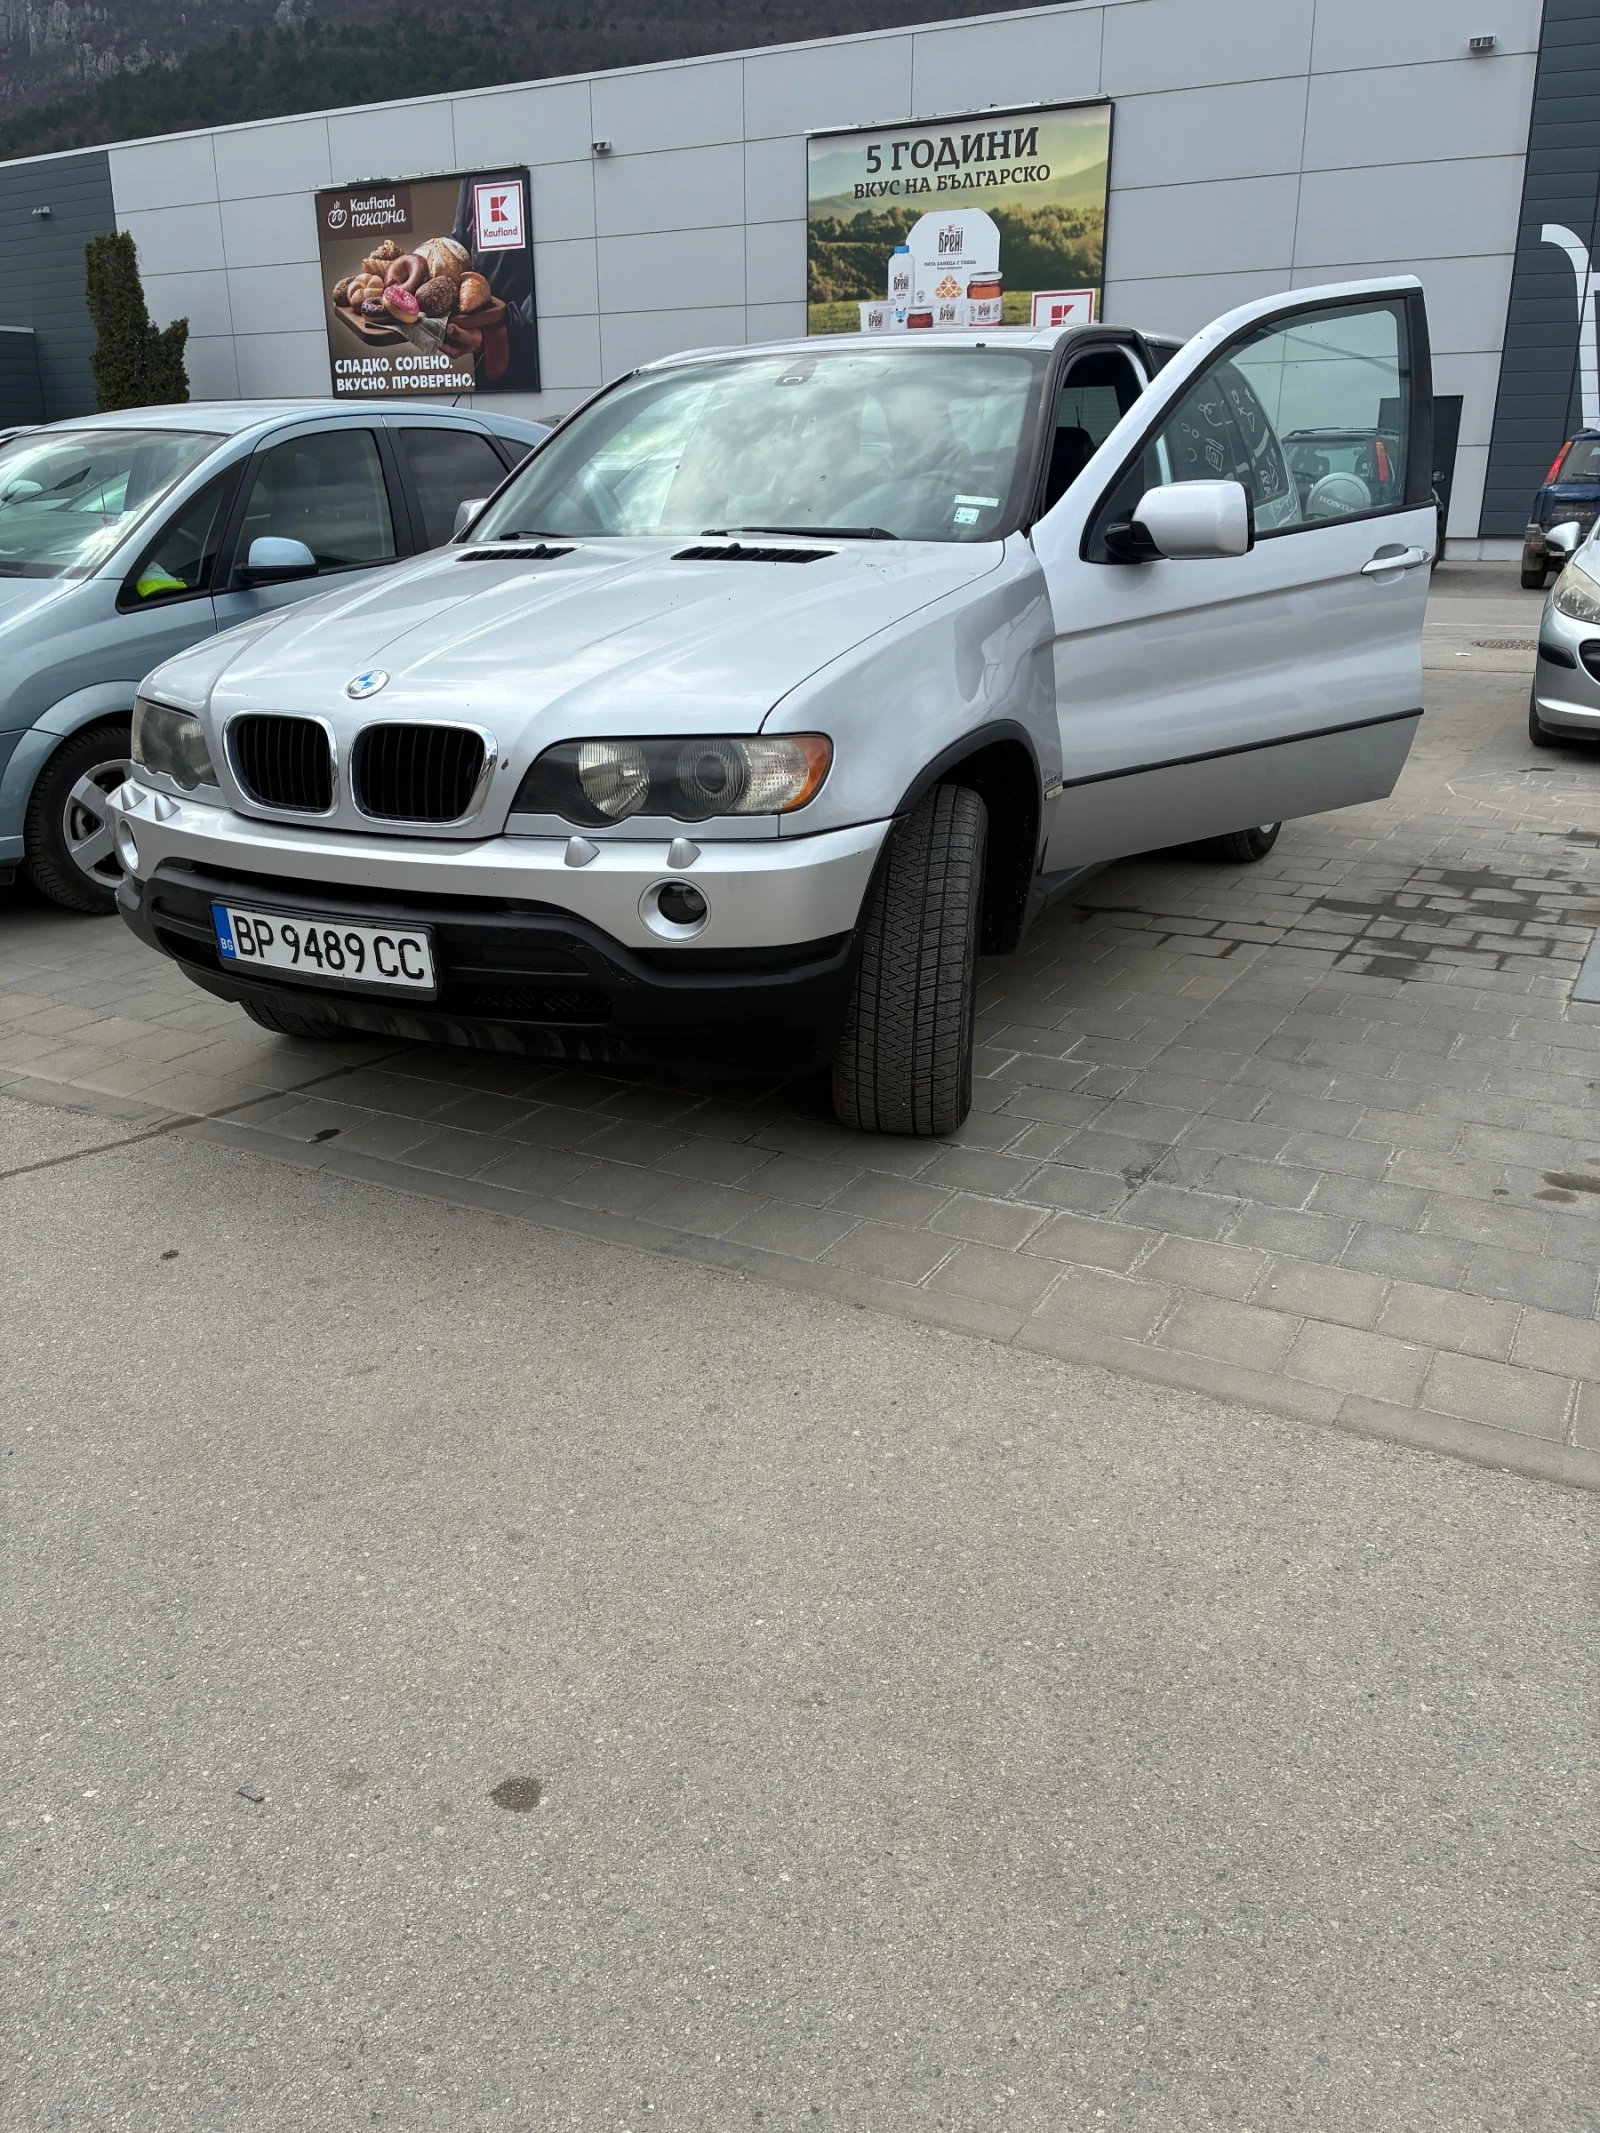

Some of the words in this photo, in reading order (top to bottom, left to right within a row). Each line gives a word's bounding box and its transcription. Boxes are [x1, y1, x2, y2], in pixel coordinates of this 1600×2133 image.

[865, 144, 882, 174] 5
[891, 126, 1039, 172] ГОДИНИ
[853, 179, 900, 199] ВКУС
[904, 176, 932, 195] НА
[936, 164, 1051, 192] БЪЛГАРСКО
[350, 194, 396, 212] Kaufland
[351, 209, 407, 229] пекарна
[483, 226, 518, 238] Kaufland
[334, 357, 393, 375] СЛАДКО.
[395, 354, 453, 371] СОЛЕНО.
[336, 376, 389, 392] ВКУСНО.
[392, 372, 475, 389] ПРОВЕРЕНО.
[1319, 496, 1355, 512] HONDA
[220, 938, 234, 951] BG
[232, 915, 274, 958] BP
[280, 924, 365, 973] 9489
[373, 935, 425, 980] CC
